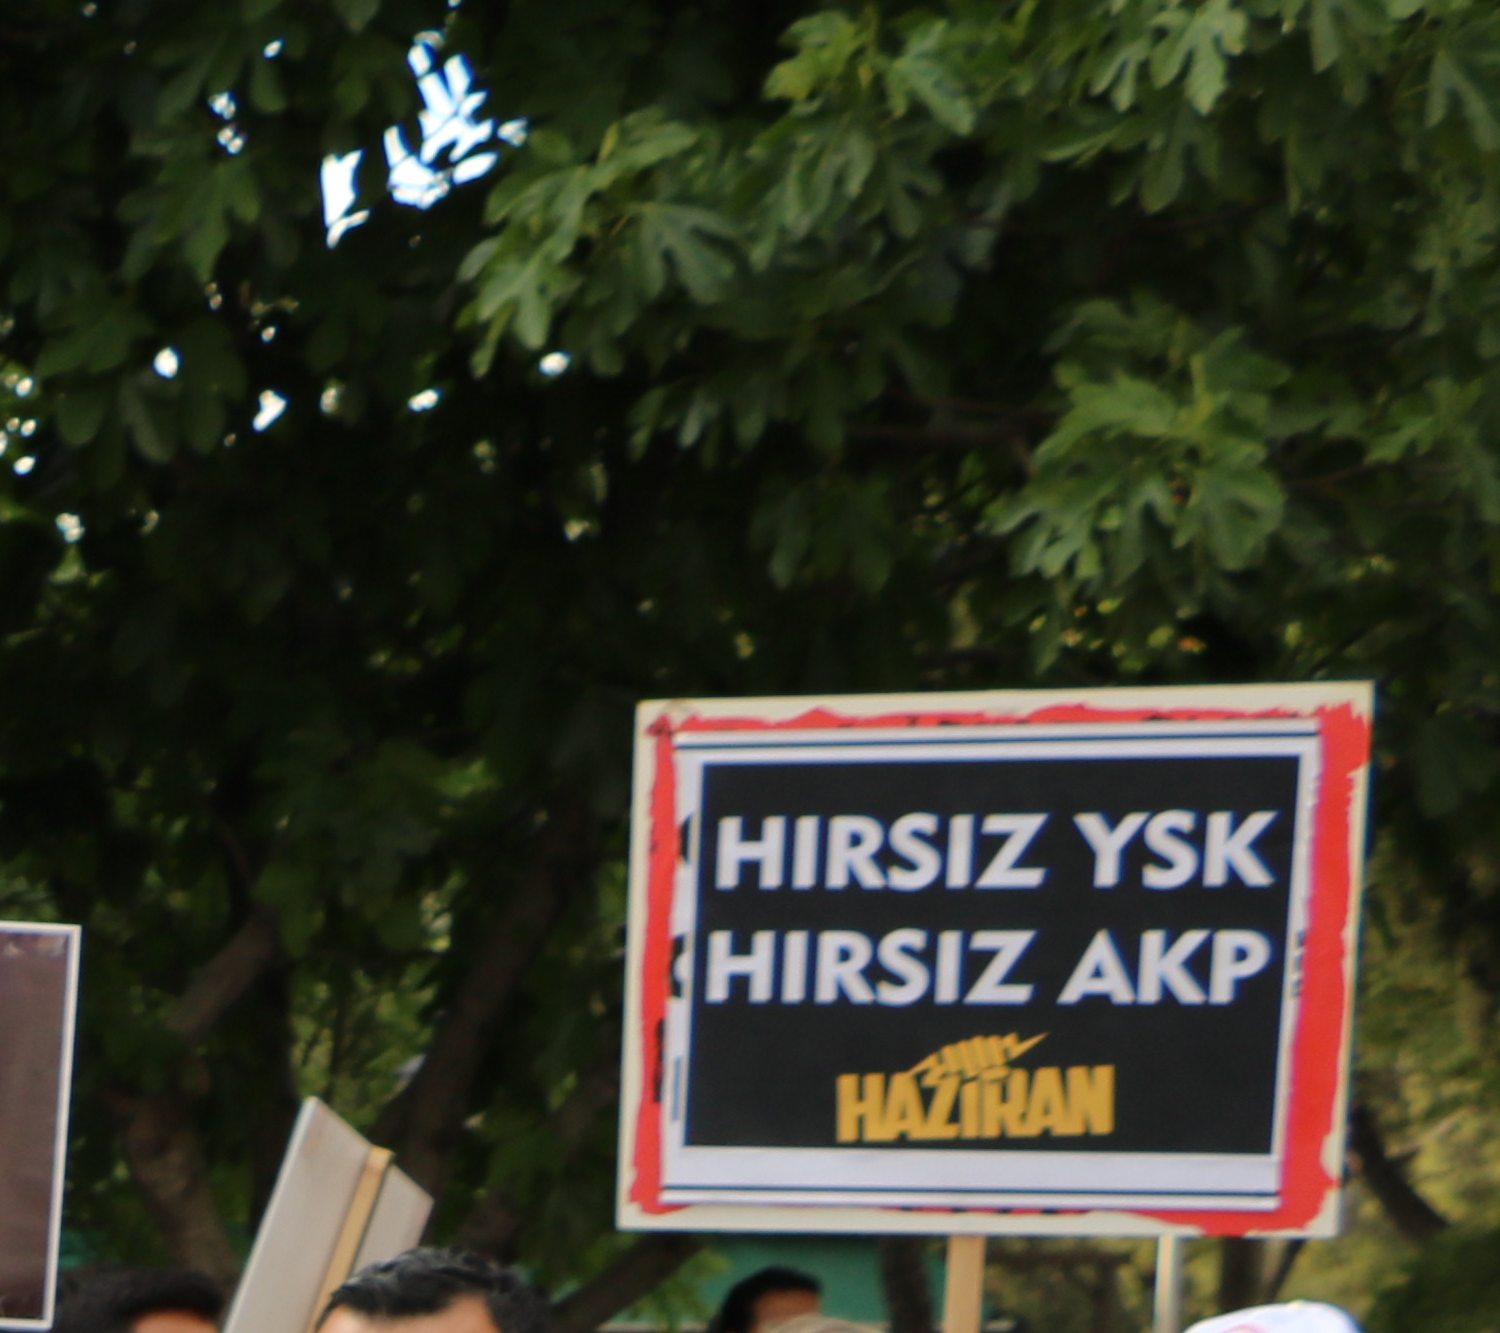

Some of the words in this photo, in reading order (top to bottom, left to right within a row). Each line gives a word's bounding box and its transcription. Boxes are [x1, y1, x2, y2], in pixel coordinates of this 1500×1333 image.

[714, 812, 1049, 891] HIRSIZ
[1072, 810, 1279, 888] YSK
[703, 929, 1037, 1005] HIRSIZ
[1056, 928, 1271, 1004] AKP
